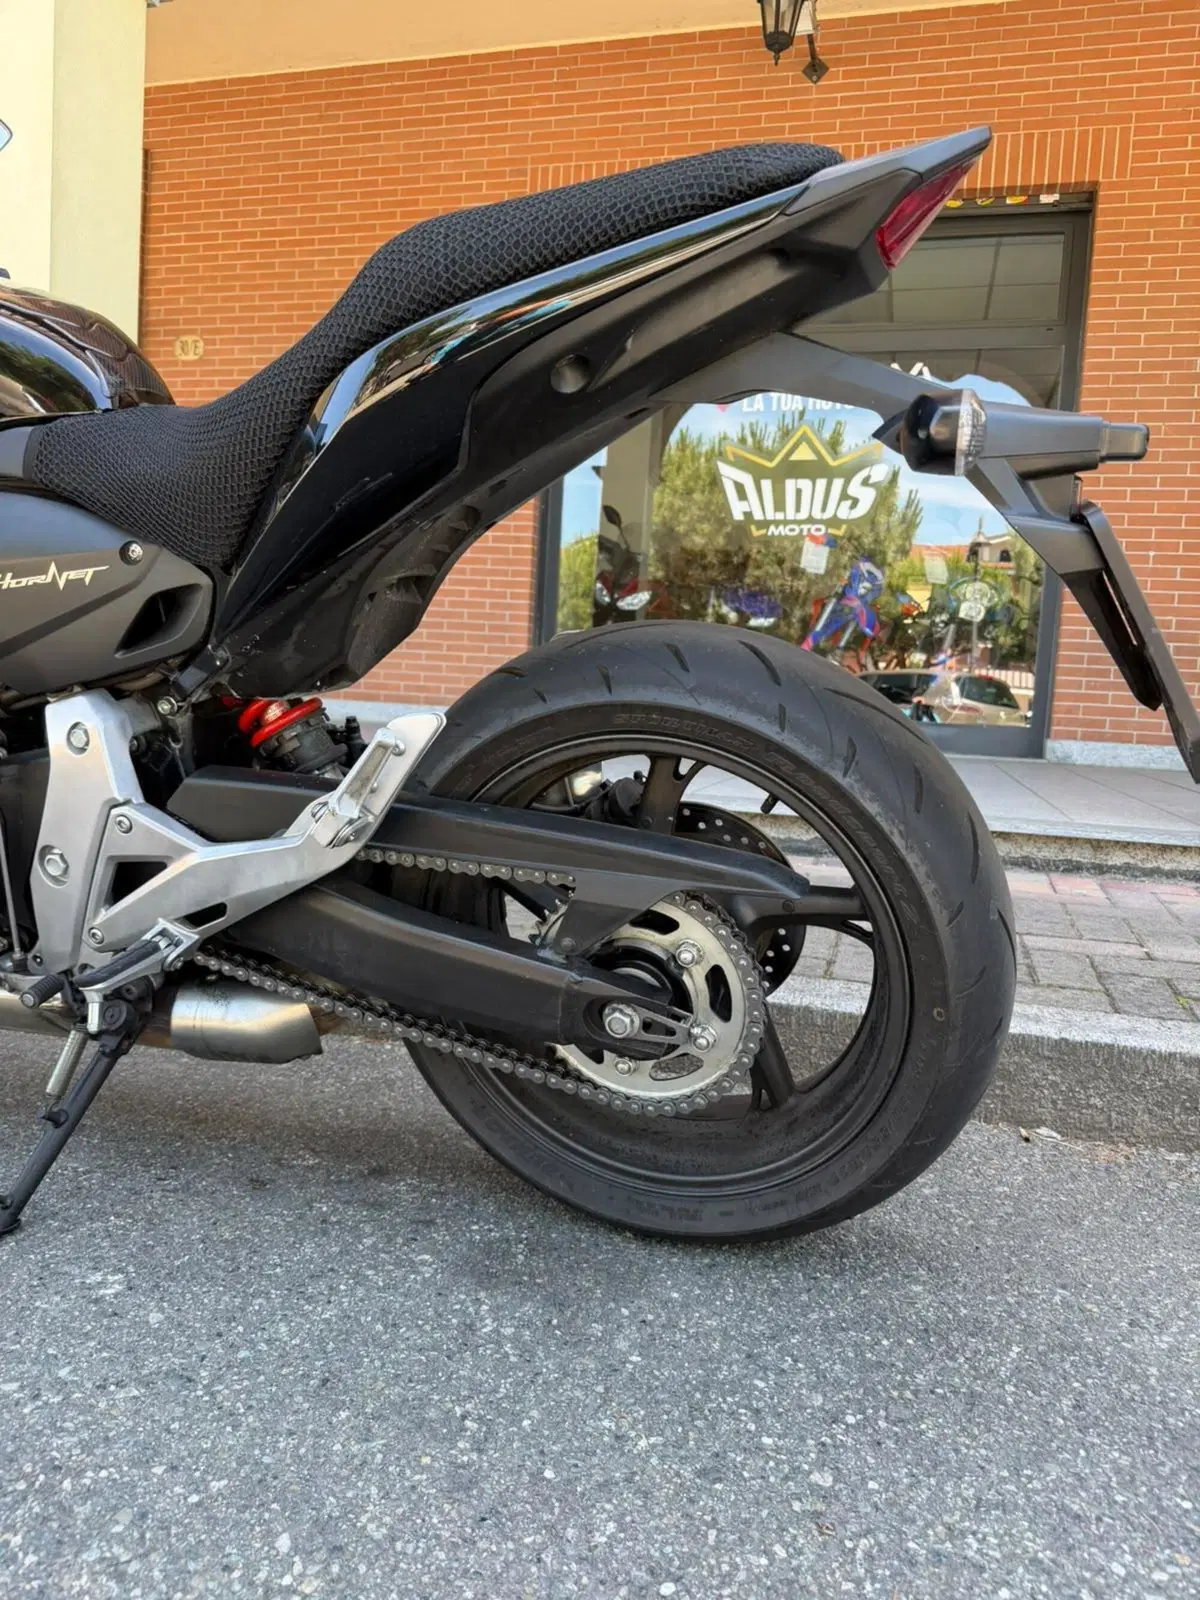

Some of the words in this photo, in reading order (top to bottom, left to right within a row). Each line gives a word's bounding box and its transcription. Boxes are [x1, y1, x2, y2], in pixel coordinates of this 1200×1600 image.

[742, 393, 765, 412] LA
[769, 392, 804, 411] TUA
[716, 460, 889, 521] ALDUS
[767, 524, 827, 537] MOTO
